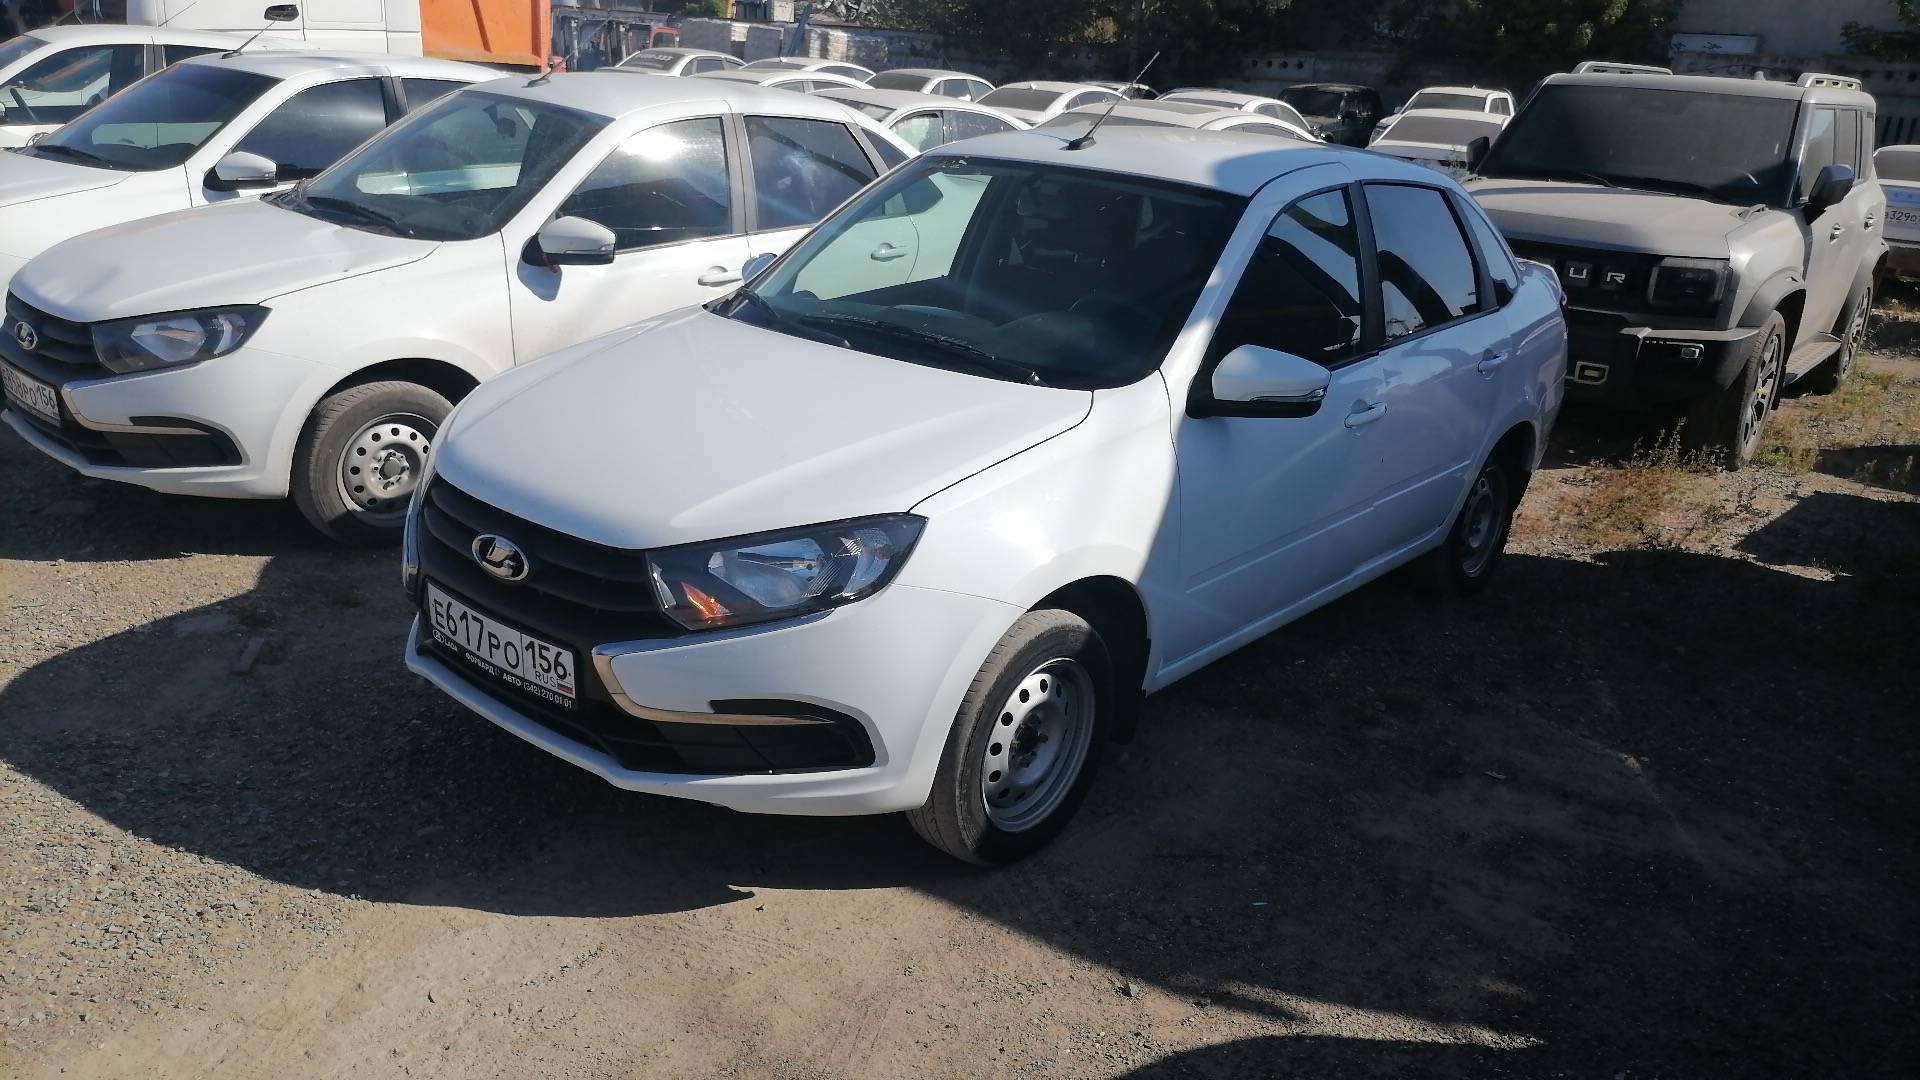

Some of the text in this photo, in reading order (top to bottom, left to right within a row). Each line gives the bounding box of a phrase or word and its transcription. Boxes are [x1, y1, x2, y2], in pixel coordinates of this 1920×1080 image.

[37, 385, 56, 409] 156
[433, 598, 568, 680] Е617РО 156
[444, 637, 459, 652] LADA
[465, 652, 572, 709] ФОРВАРД АВТО (342) 270 01 01
[535, 671, 558, 688] RUS
